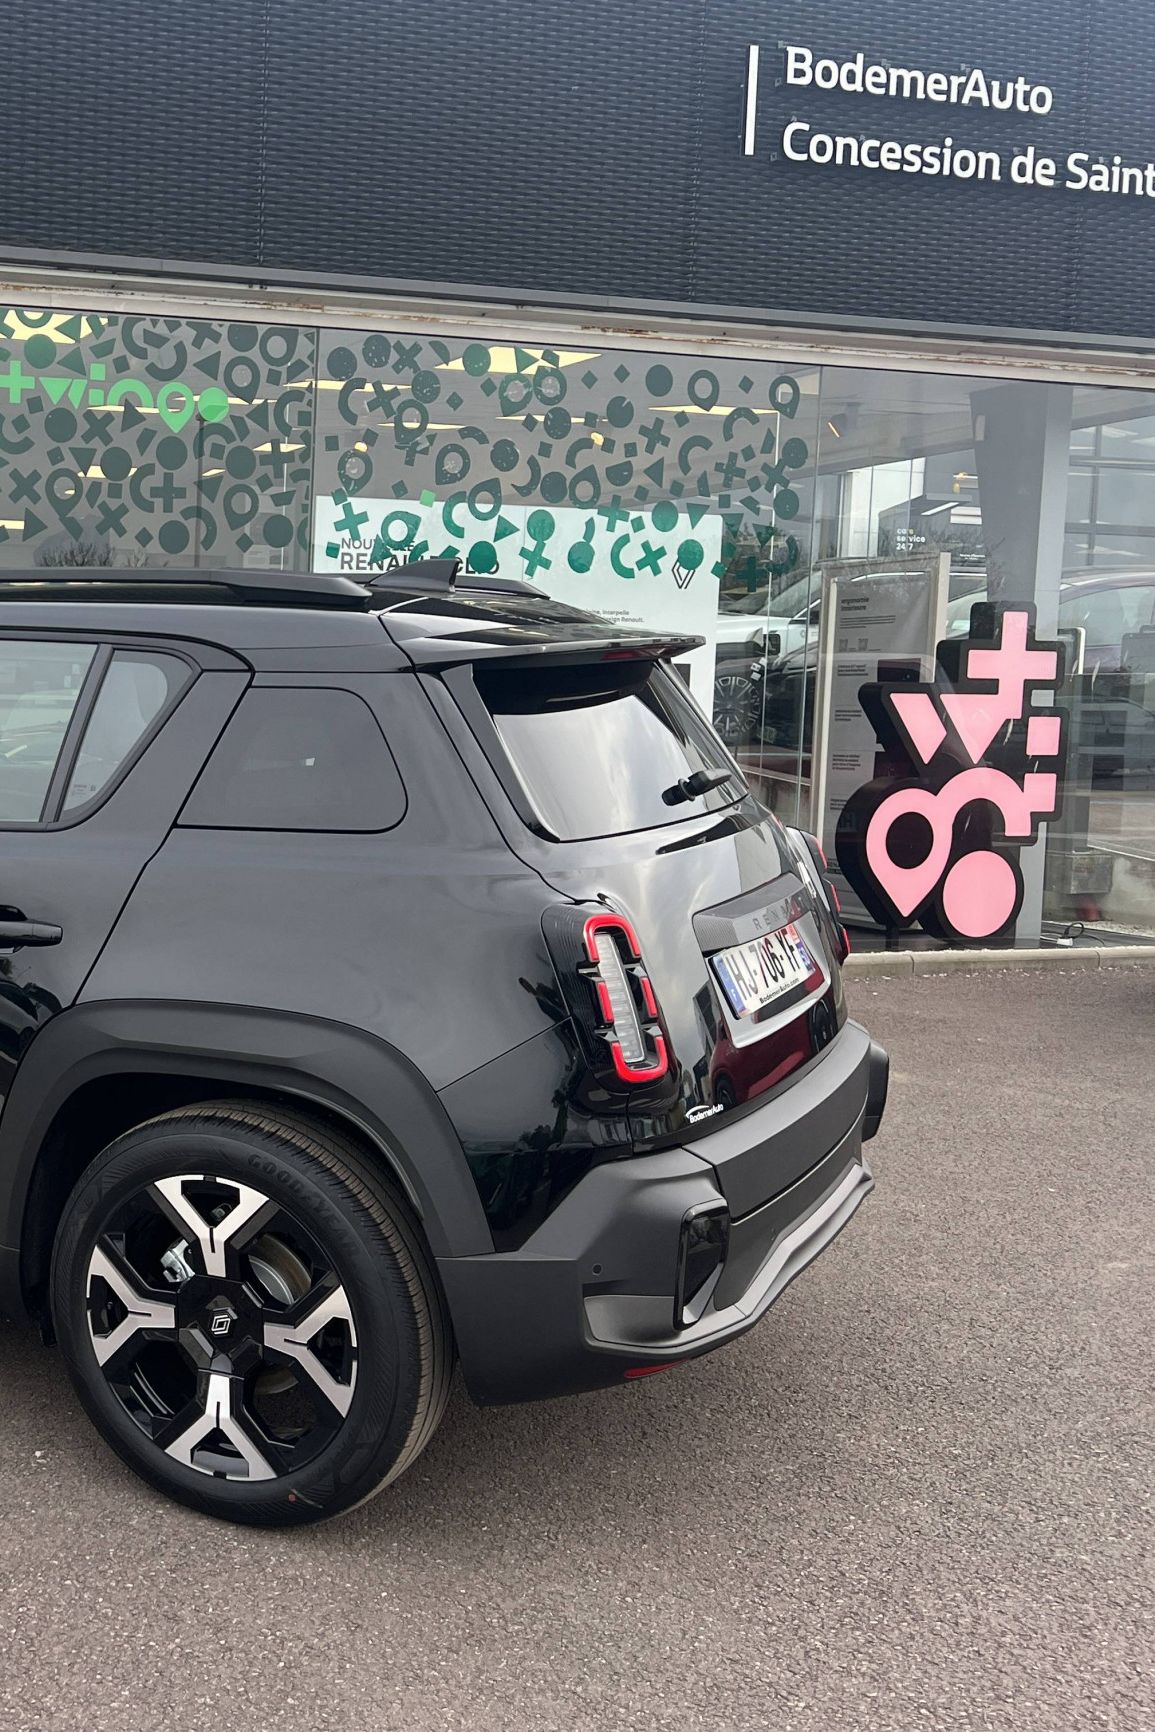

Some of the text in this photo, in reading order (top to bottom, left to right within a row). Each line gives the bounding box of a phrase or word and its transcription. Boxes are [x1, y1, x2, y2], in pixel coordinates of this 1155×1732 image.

[785, 46, 1053, 114] BodemerAuto
[782, 121, 1001, 181] Concession
[1010, 146, 1057, 186] de
[758, 977, 800, 1005] BodemerAuto.com
[689, 1103, 724, 1124] BodemerAuto
